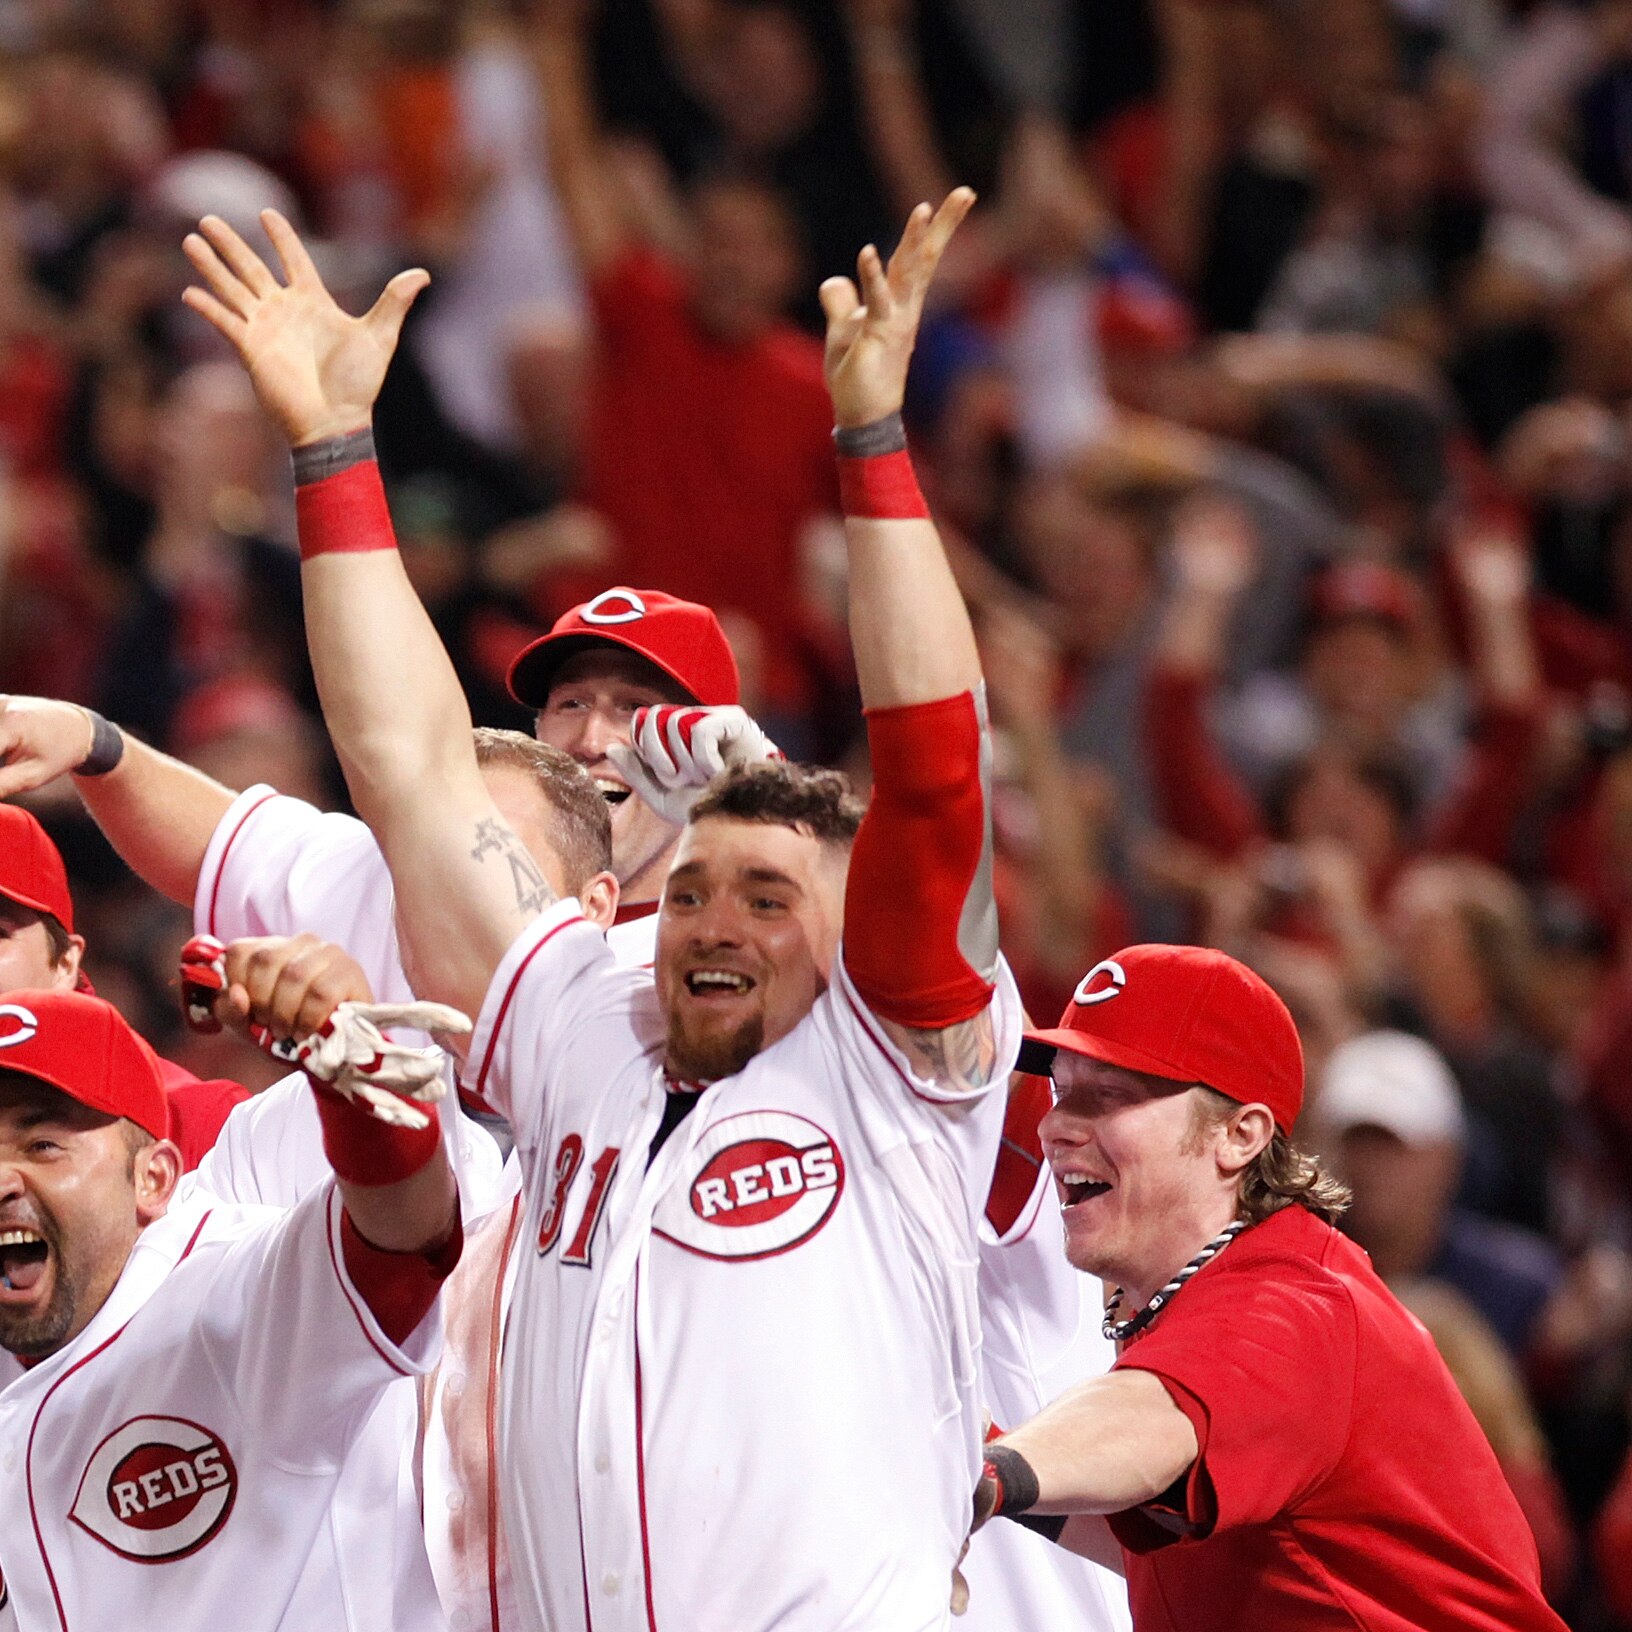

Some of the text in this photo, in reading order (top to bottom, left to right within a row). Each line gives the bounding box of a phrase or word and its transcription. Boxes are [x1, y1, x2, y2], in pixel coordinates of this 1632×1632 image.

[537, 1132, 621, 1269] 31
[695, 1147, 838, 1218] REDS
[112, 1447, 229, 1519] REDS
